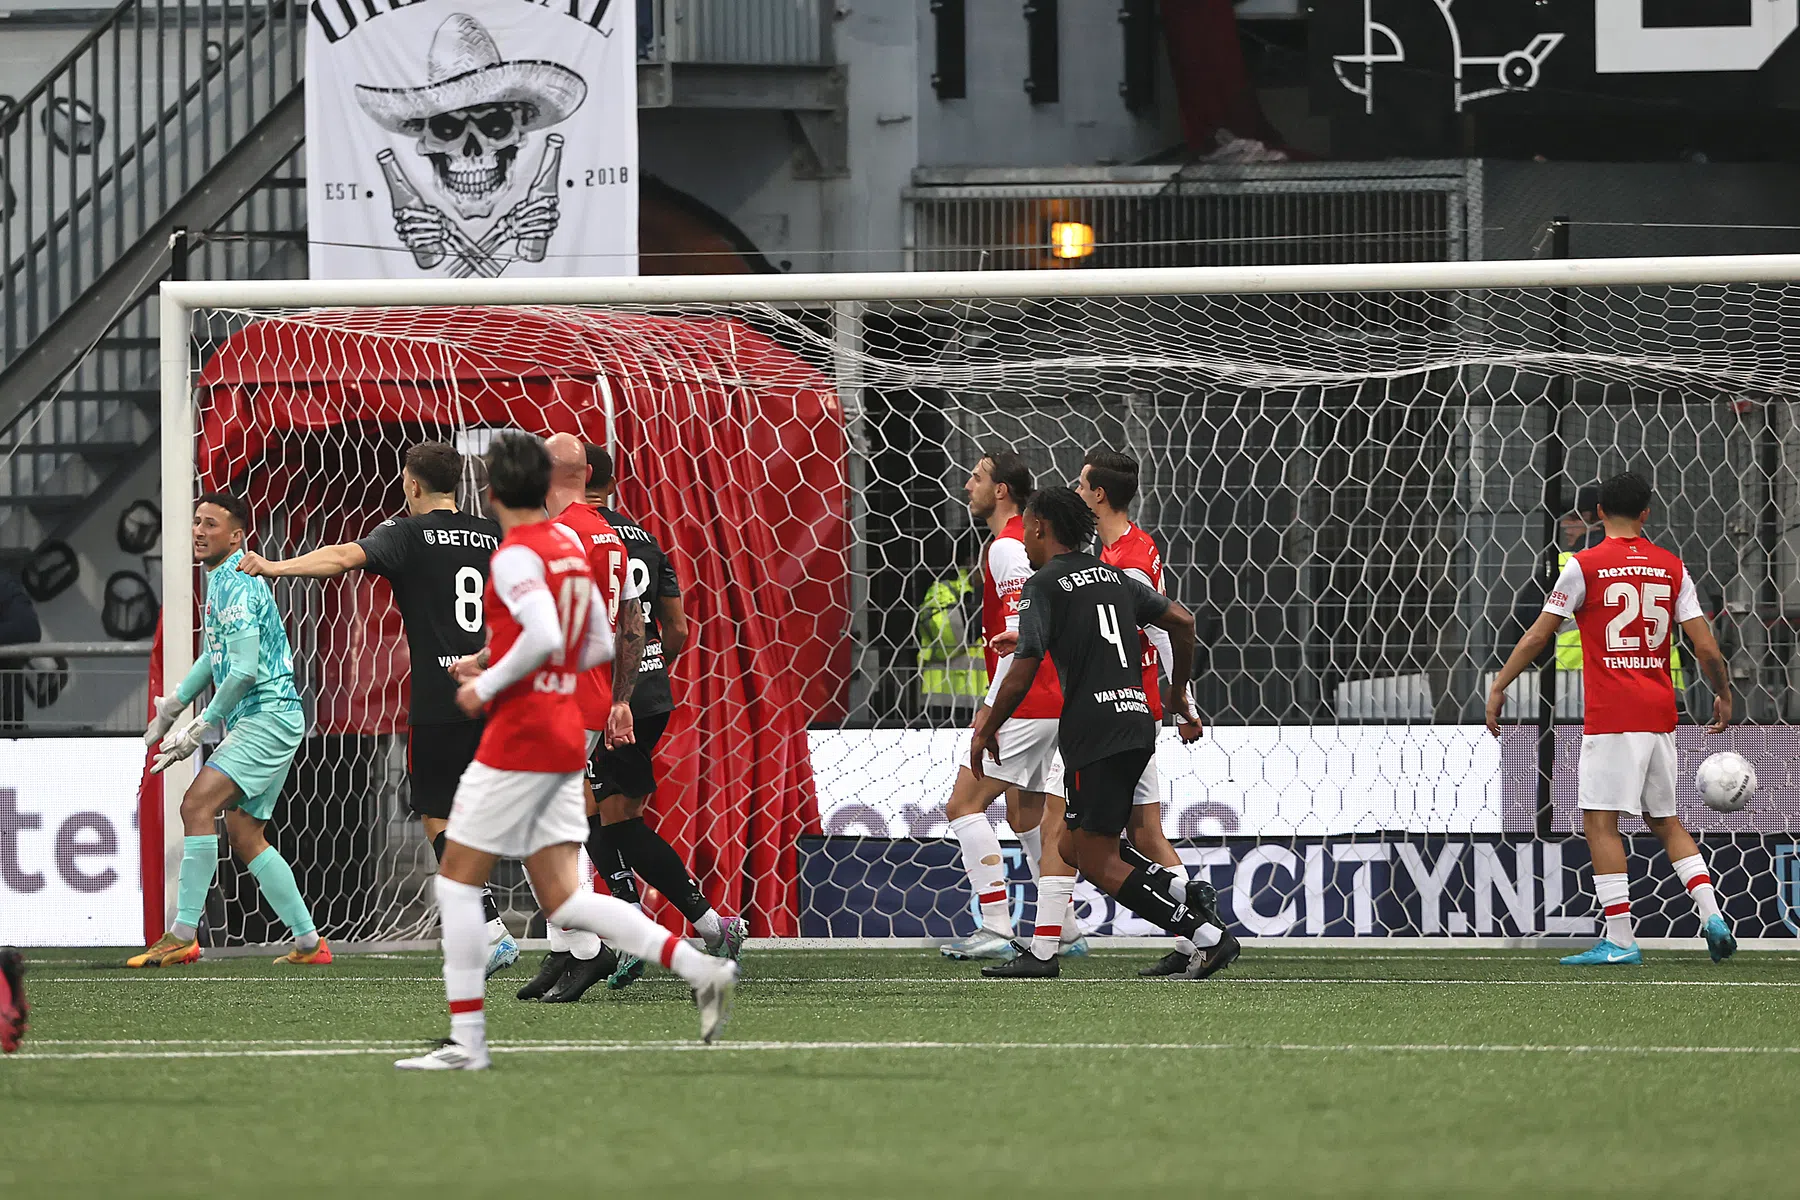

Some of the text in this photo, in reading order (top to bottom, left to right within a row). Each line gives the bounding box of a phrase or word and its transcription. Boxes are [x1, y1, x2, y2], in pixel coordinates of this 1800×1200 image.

[325, 167, 629, 201] EST 2018
[437, 529, 499, 551] BETCITY
[609, 525, 652, 543] TCITY
[455, 566, 484, 633] 8
[608, 550, 621, 626] 5
[1070, 566, 1122, 587] BETCITY
[550, 576, 592, 666] 17
[1096, 603, 1129, 669] 4
[1604, 582, 1672, 652] 25
[1094, 689, 1118, 703] VAN
[0, 786, 143, 894] te
